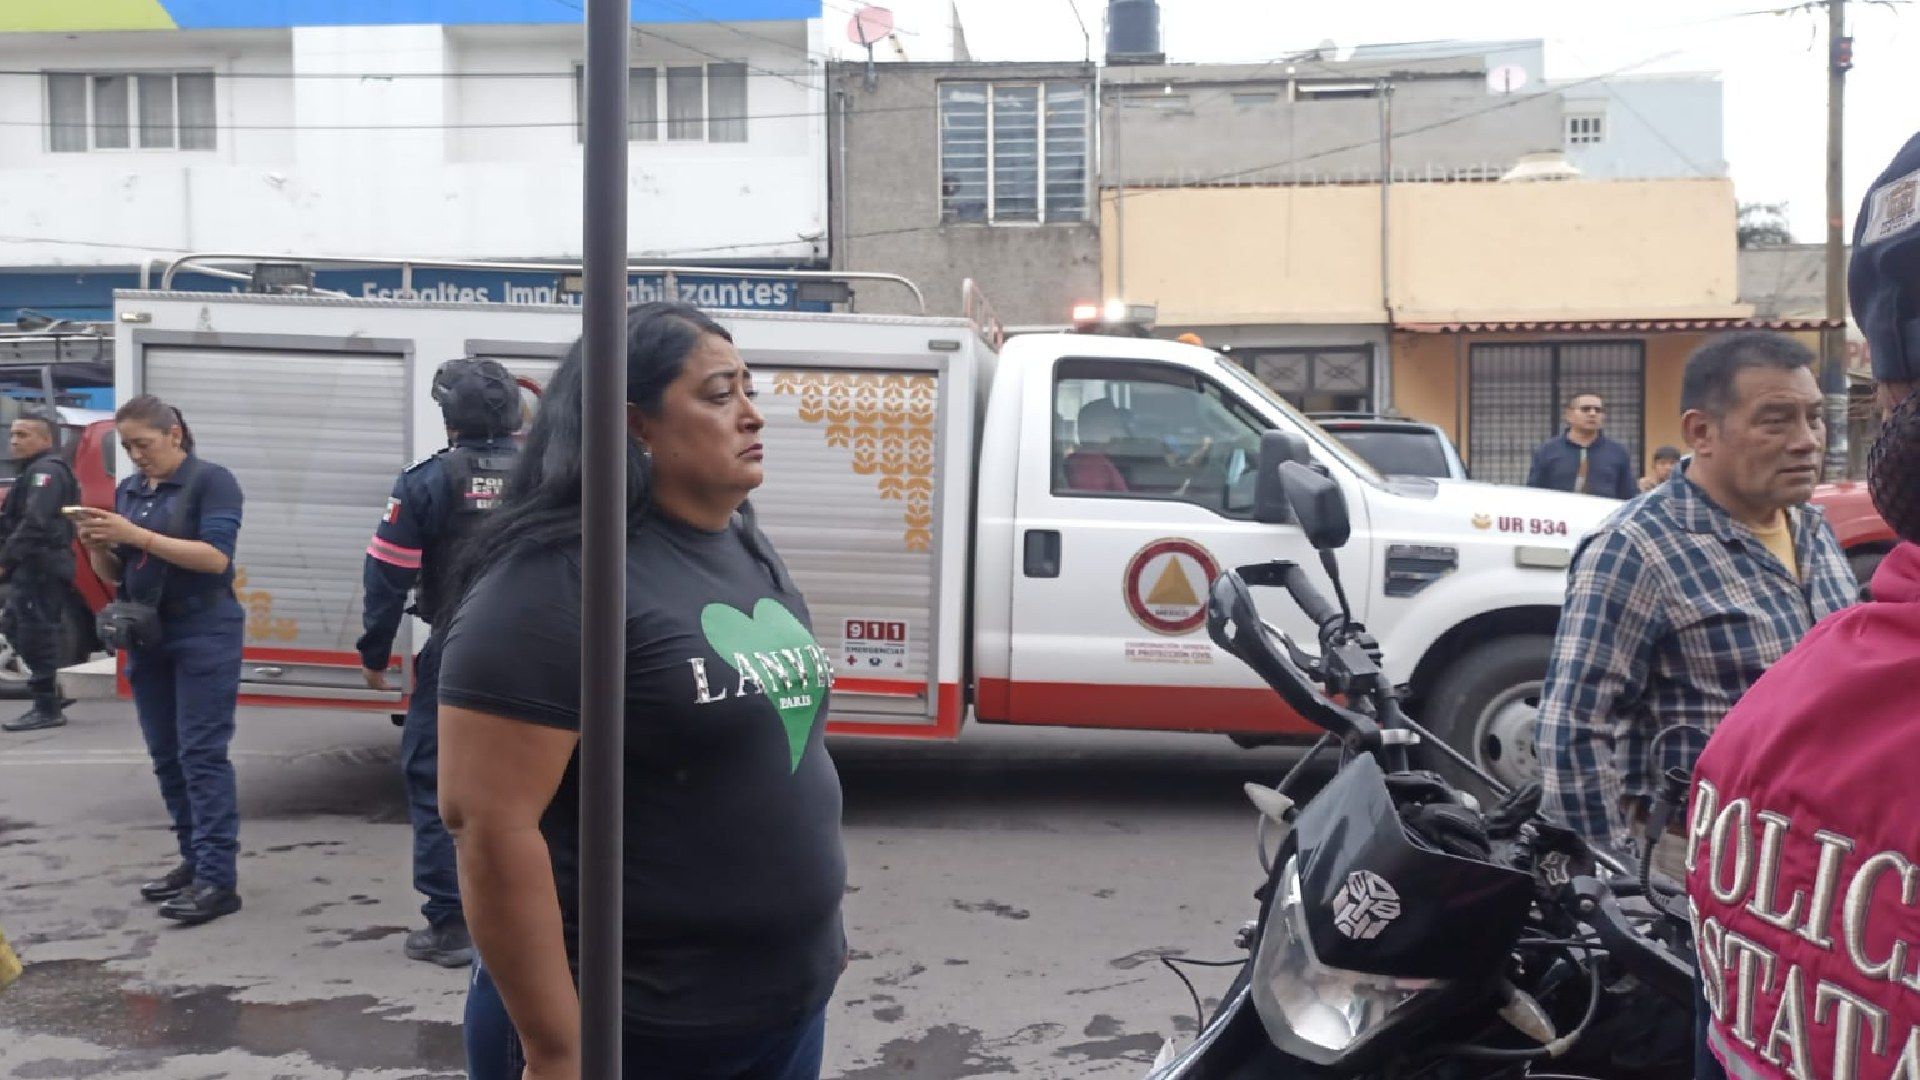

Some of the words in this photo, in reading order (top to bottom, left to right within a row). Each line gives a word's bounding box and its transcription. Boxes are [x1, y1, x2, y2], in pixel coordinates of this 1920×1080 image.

[1498, 516, 1524, 533] UR
[1530, 518, 1567, 537] 934
[849, 622, 901, 640] 911
[1685, 779, 1920, 991] POLIC
